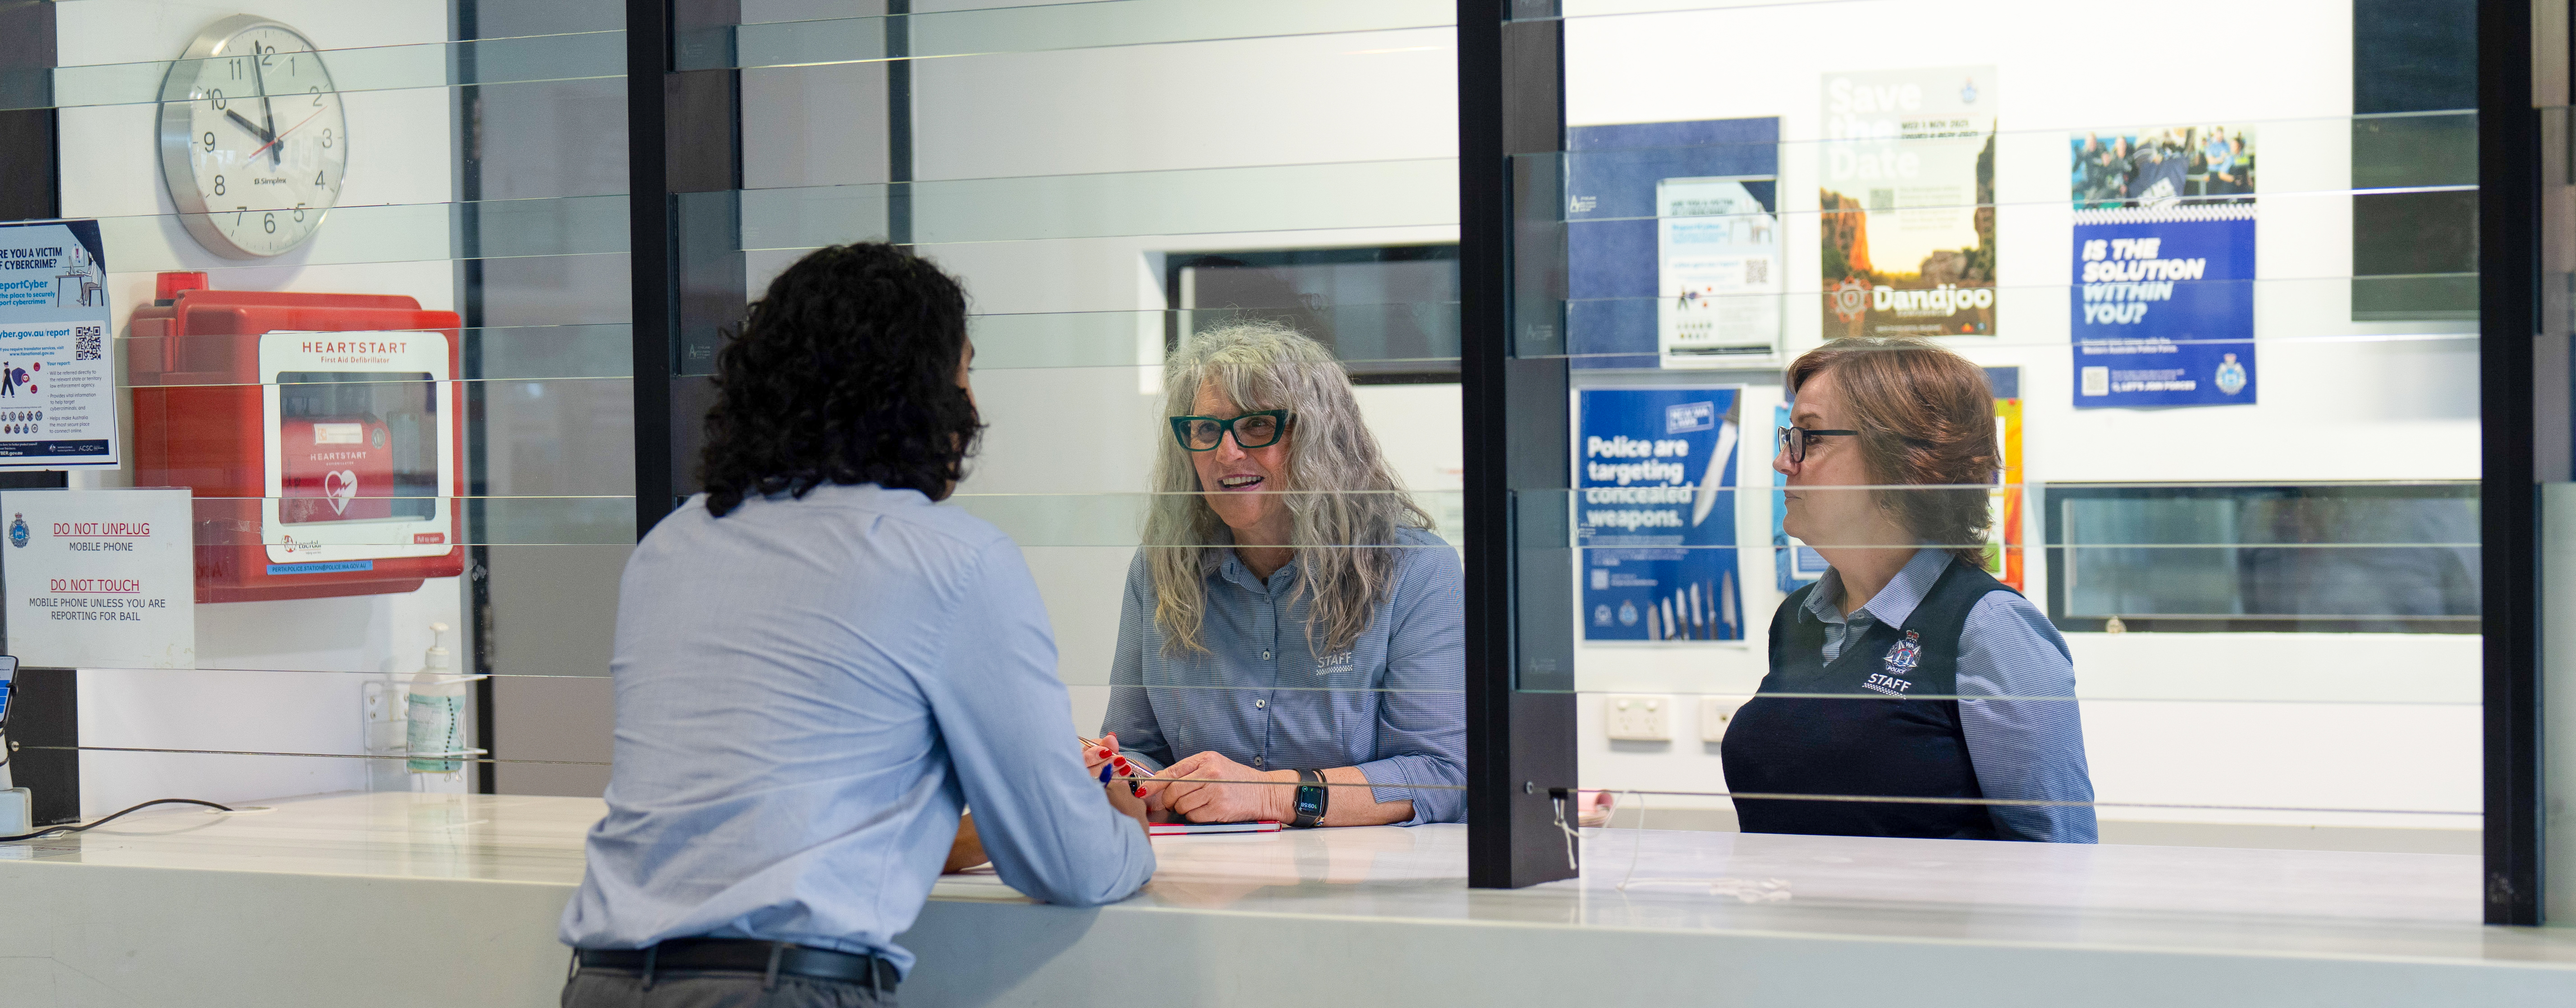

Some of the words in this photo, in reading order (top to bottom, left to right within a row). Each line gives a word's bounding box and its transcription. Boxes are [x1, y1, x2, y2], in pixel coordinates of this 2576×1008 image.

[229, 58, 242, 80] 11
[291, 57, 295, 77] 1
[206, 88, 226, 110] 10
[310, 86, 323, 106] 2
[1829, 77, 1922, 113] Save
[322, 128, 333, 148] 3
[1829, 113, 1895, 146] the
[204, 132, 215, 152] 9
[1828, 146, 1920, 182] Date
[215, 175, 225, 196] 8
[261, 177, 286, 186] Simplex
[315, 170, 325, 190] 4
[237, 206, 247, 226] 7
[294, 203, 305, 222] 5
[264, 213, 276, 233] 6
[0, 249, 8, 258] RE
[10, 248, 27, 258] YOU
[29, 248, 34, 258] A
[35, 247, 62, 257] VICTIM
[2082, 239, 2108, 262] IS
[2112, 237, 2162, 260] THE
[5, 258, 57, 270] CYBERCRIME?
[2082, 258, 2206, 283] SOLUTION
[0, 279, 48, 292] eportCyber
[2082, 281, 2174, 302] WITHIN
[1872, 283, 1994, 317] Dandjoo
[2082, 301, 2148, 324] YOU?
[0, 328, 70, 340] yber.gov.au/report
[303, 342, 407, 353] HEARTSTART
[310, 452, 366, 461] HEARTSTART
[1587, 435, 1653, 458] Police
[1654, 438, 1689, 457] are
[1588, 459, 1685, 486] targeting
[1586, 481, 1695, 505] concealed
[54, 523, 70, 534] DO
[75, 523, 98, 534] NOT
[102, 523, 150, 535] UNPLUG
[1586, 510, 1684, 532] weapons.
[69, 542, 101, 551] MOBILE
[104, 542, 133, 551] PHONE
[51, 579, 66, 591] DO
[71, 579, 94, 591] NOT
[98, 579, 139, 591] TOUCH
[29, 598, 58, 607] MOBILE
[61, 598, 87, 607] PHONE
[91, 598, 124, 608] UNLESS
[127, 599, 145, 608] YOU
[149, 599, 165, 608] ARE
[51, 611, 97, 620] REPORTING
[100, 611, 116, 620] FOR
[120, 612, 141, 621] BAIL
[1317, 652, 1352, 668] STAFF
[1887, 666, 1906, 675] POLICE
[1868, 673, 1912, 692] STAFF
